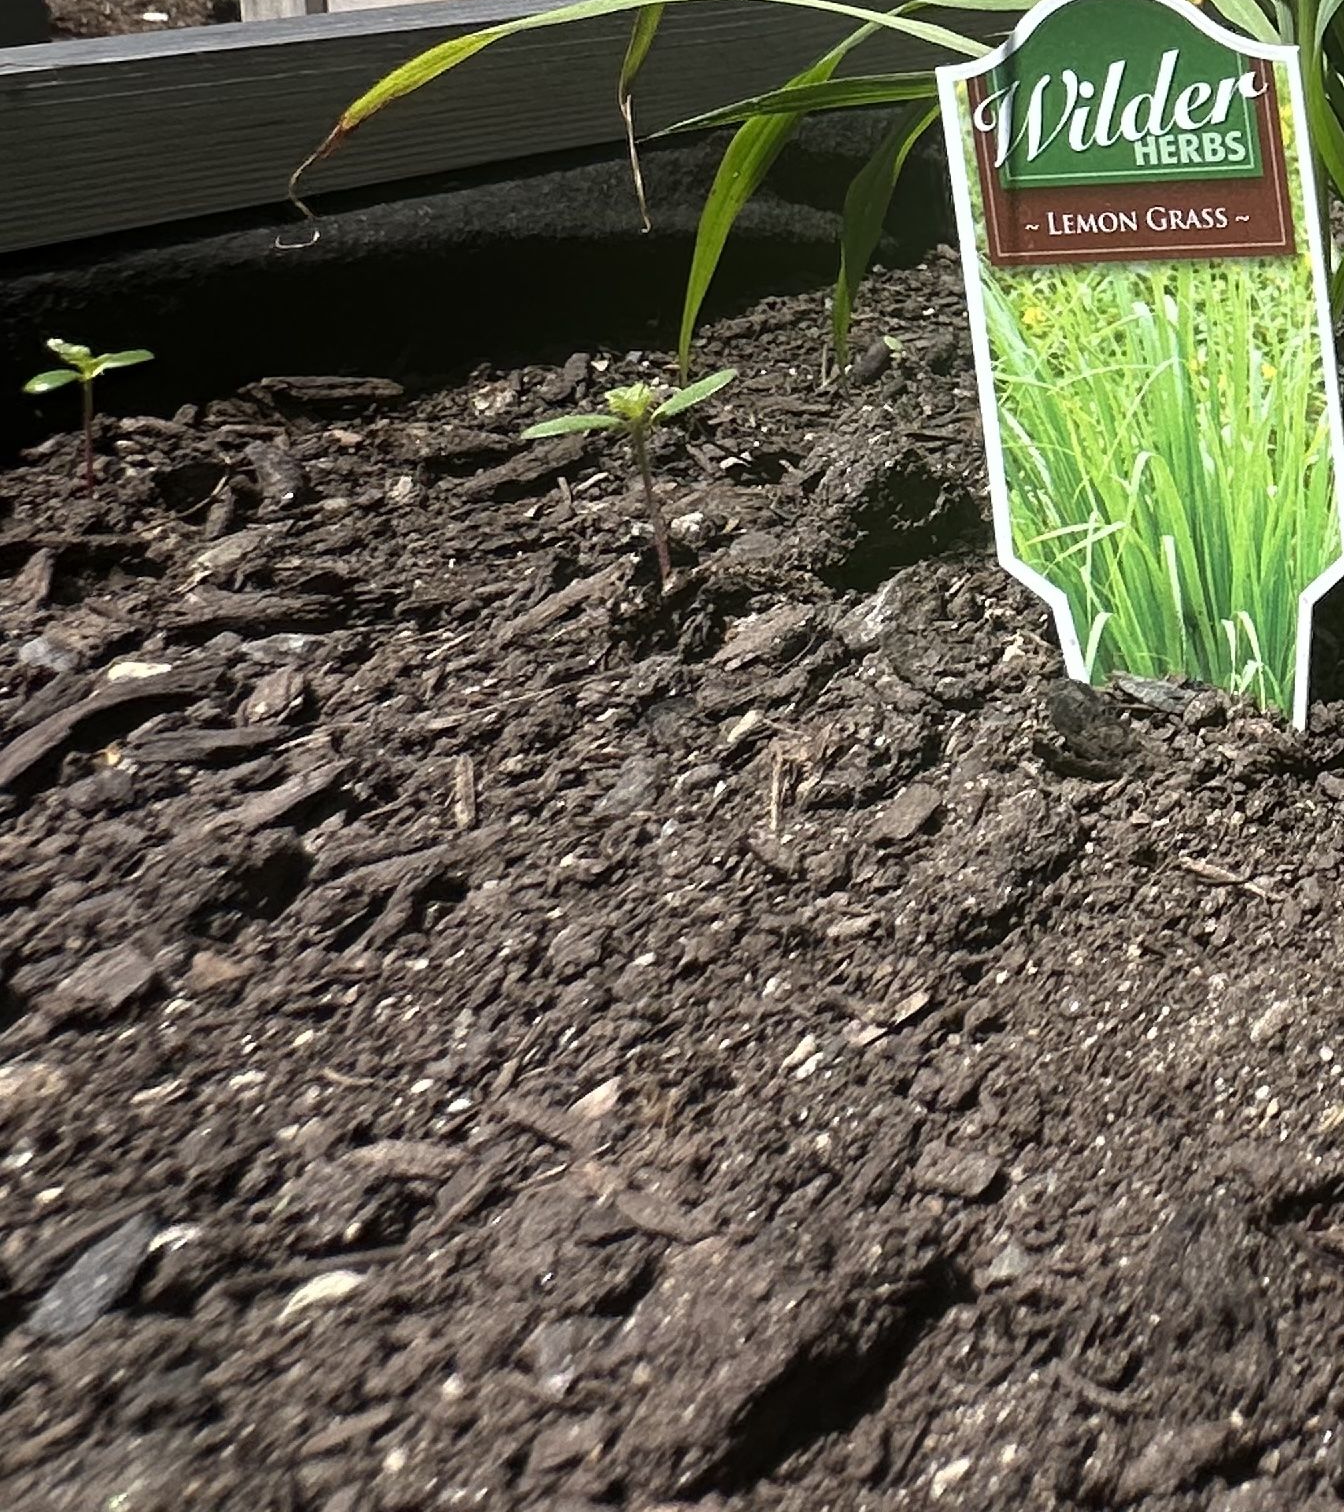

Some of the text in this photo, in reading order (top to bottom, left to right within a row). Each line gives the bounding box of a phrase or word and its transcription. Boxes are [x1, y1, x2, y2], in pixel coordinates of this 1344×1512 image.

[973, 48, 1268, 168] Wilder
[1134, 131, 1247, 167] HERBS
[1047, 206, 1228, 236] LEMON GRASS
